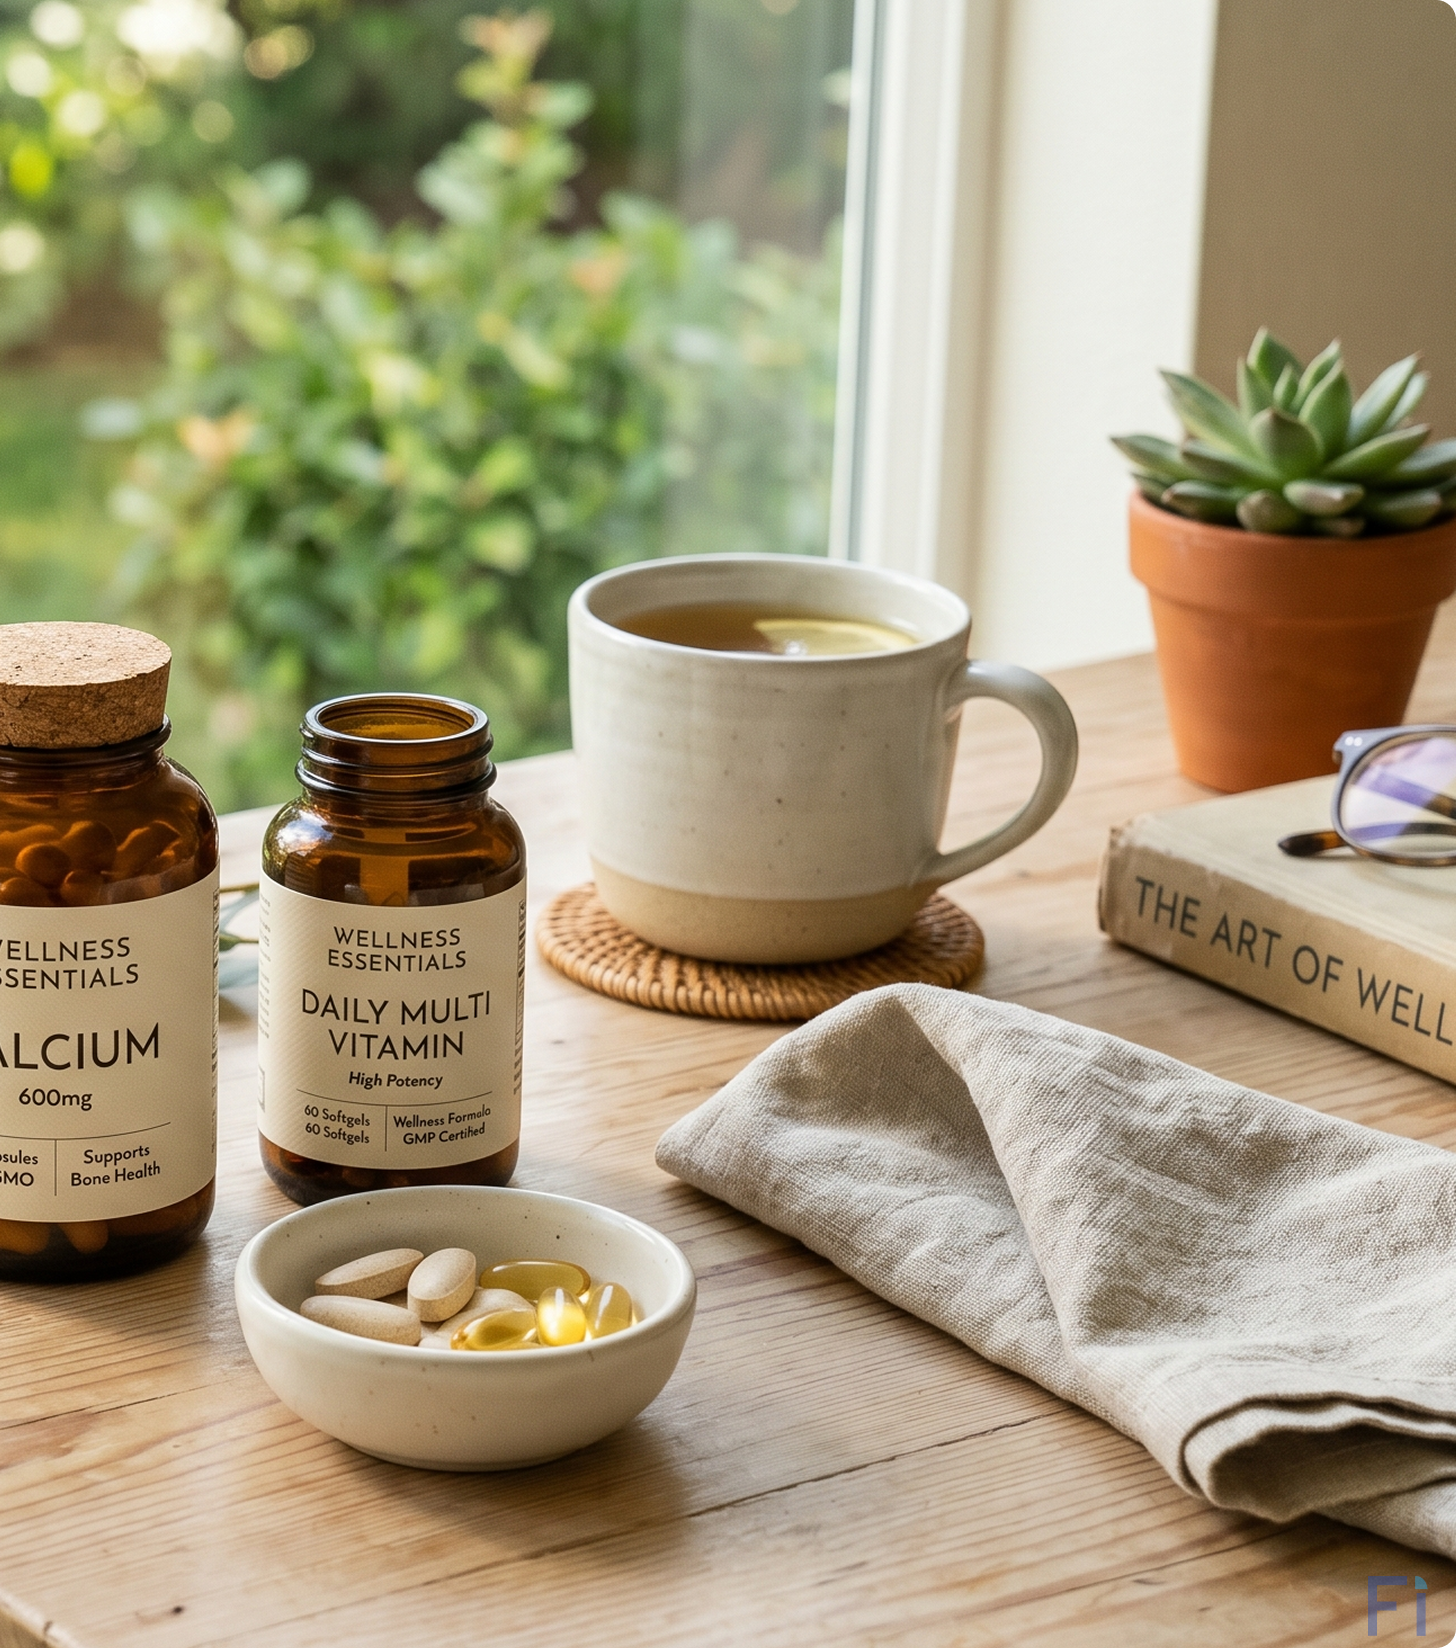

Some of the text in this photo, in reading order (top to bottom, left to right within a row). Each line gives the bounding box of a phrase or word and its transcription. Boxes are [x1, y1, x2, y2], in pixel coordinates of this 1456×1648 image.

[333, 926, 461, 949] WELLNESS
[328, 949, 467, 972] ESSENTIALS
[1135, 875, 1453, 1047] THE ART OF WELL
[302, 988, 491, 1025] DAILY MULTI
[328, 1029, 464, 1060] VITAMIN
[348, 1071, 443, 1090] High Potency
[18, 1087, 93, 1112] 600mg
[304, 1104, 370, 1128] 60 Softgels
[393, 1114, 445, 1128] Wellness
[305, 1122, 370, 1145] 60 Softgels
[403, 1131, 436, 1145] GMP
[83, 1145, 150, 1167] Supports
[71, 1160, 161, 1187] Bone Health
